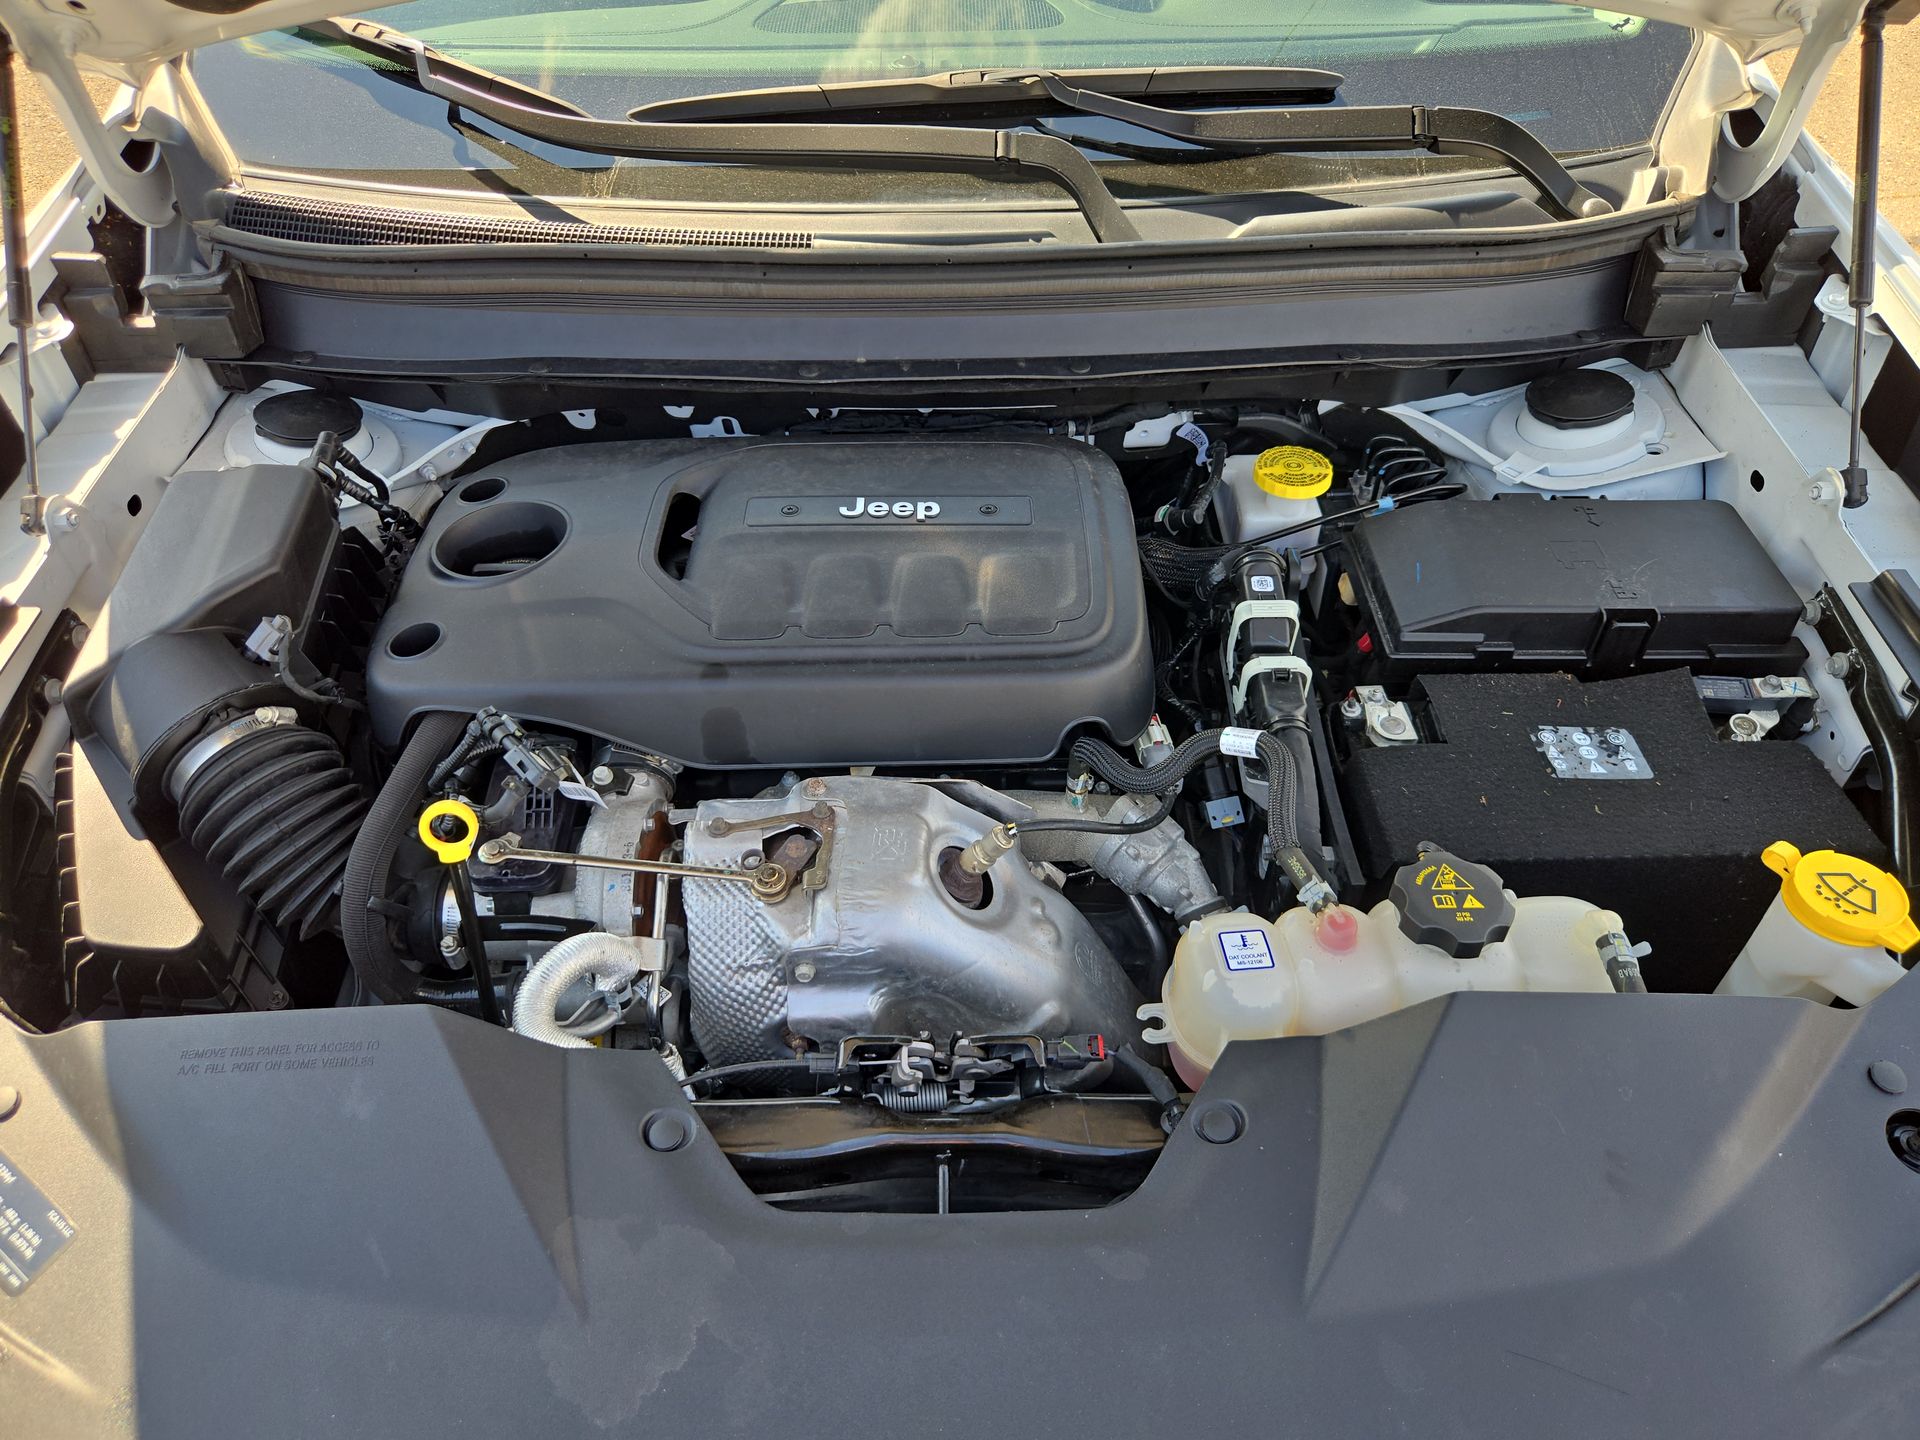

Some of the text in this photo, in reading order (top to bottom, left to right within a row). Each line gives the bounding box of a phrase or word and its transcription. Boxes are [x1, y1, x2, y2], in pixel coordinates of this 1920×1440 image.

[839, 497, 941, 521] Jeep
[180, 1039, 380, 1060] REMOVE THIS PANEL FOR ACCESS TO
[177, 1055, 375, 1076] A/C FILL PORT ON SOME VEHICLES
